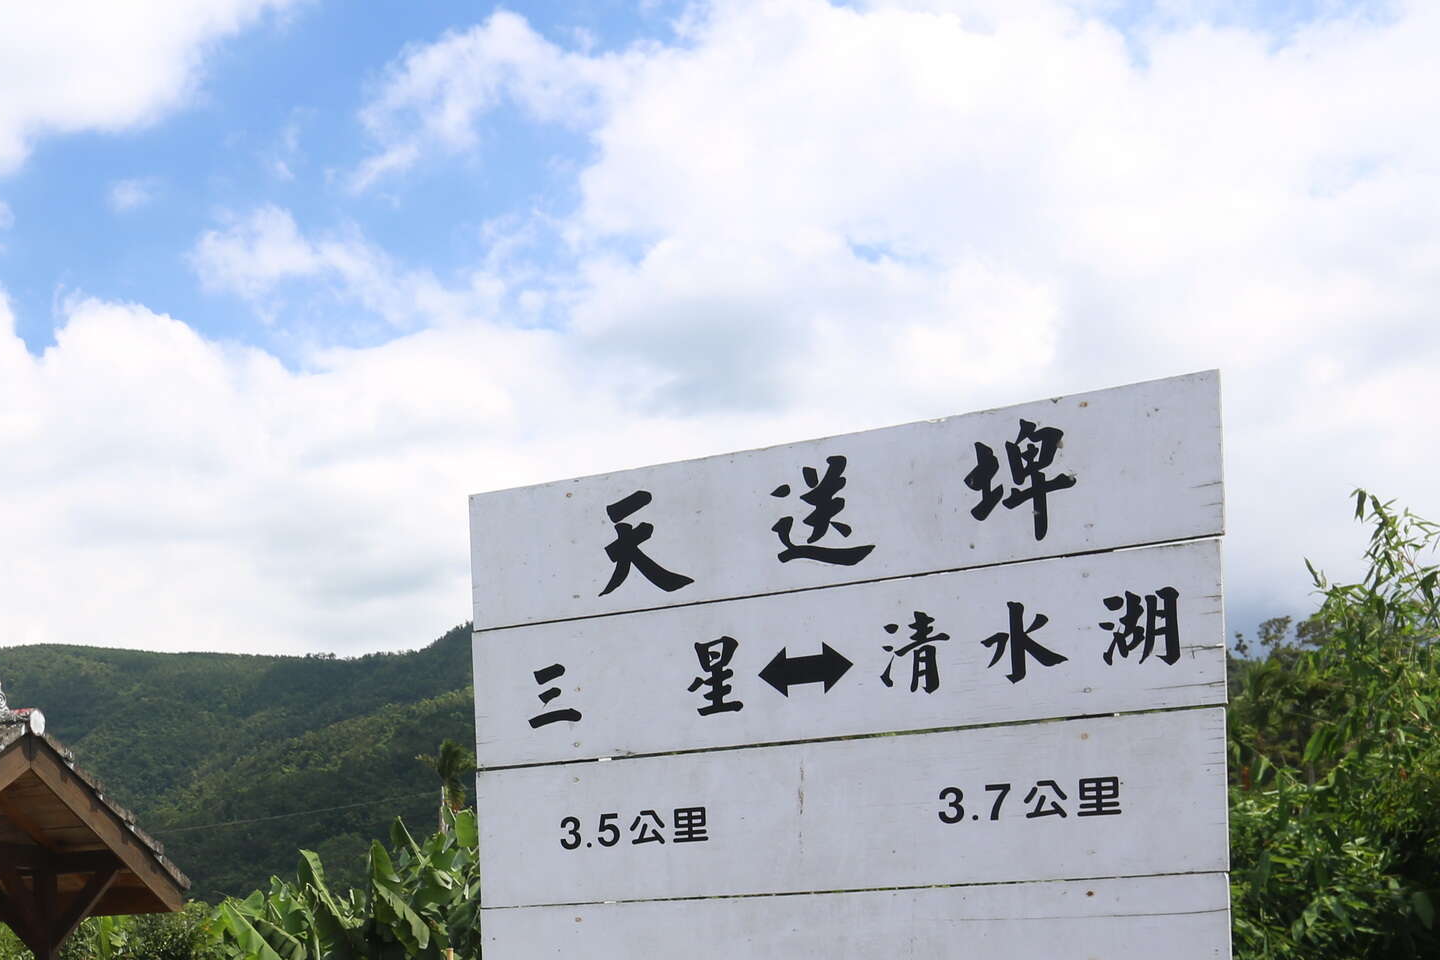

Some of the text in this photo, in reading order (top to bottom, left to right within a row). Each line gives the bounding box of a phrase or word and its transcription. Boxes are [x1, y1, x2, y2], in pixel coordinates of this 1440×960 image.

[599, 419, 1076, 596] 天送埤
[528, 636, 743, 728] 三星
[880, 587, 1180, 693] 清水湖
[561, 807, 708, 849] 3.5公里
[939, 777, 1121, 823] 3.7公里
